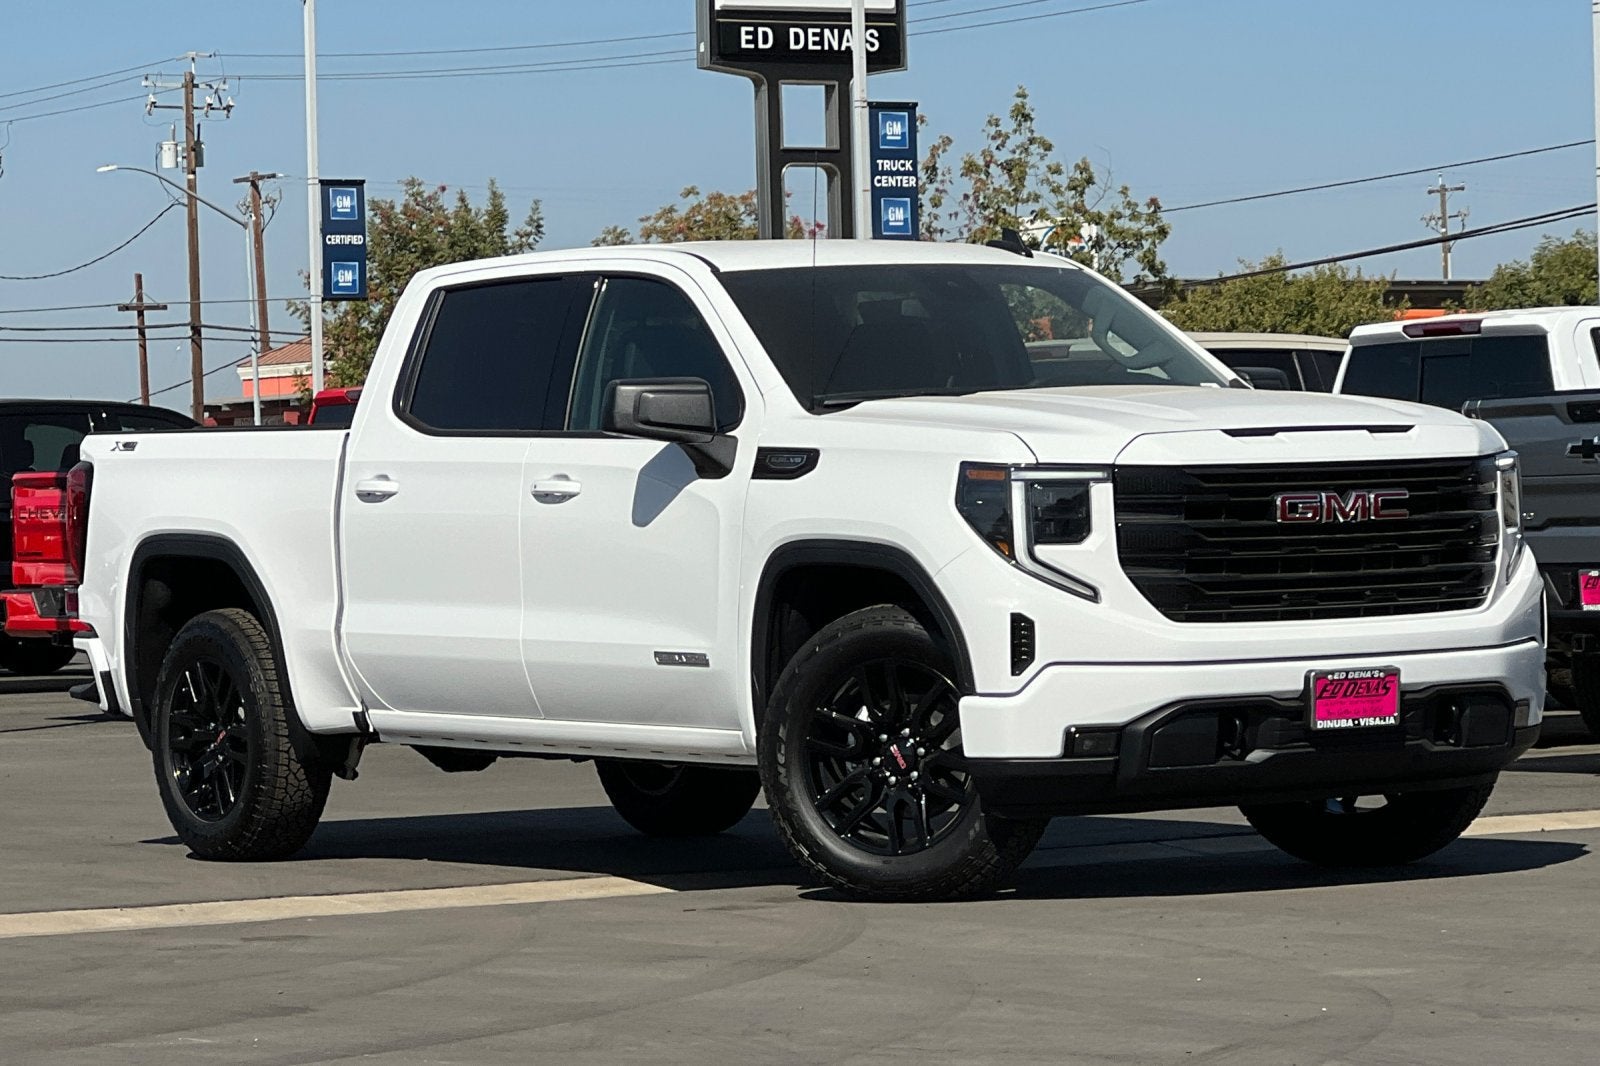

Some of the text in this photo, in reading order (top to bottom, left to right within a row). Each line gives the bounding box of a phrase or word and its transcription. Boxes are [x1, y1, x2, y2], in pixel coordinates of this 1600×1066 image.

[740, 26, 880, 52] ED DENAS
[886, 121, 901, 135] GM
[876, 159, 913, 172] TRUCK
[874, 175, 917, 188] CENTER
[336, 195, 351, 209] GM
[888, 207, 904, 222] GM
[326, 234, 364, 244] CERTIFIED
[338, 269, 352, 282] GM
[1276, 491, 1409, 523] GMC
[1333, 670, 1379, 680] ED DENA'S
[1318, 682, 1344, 700] ED
[1317, 716, 1396, 728] DINUBA VISALIA
